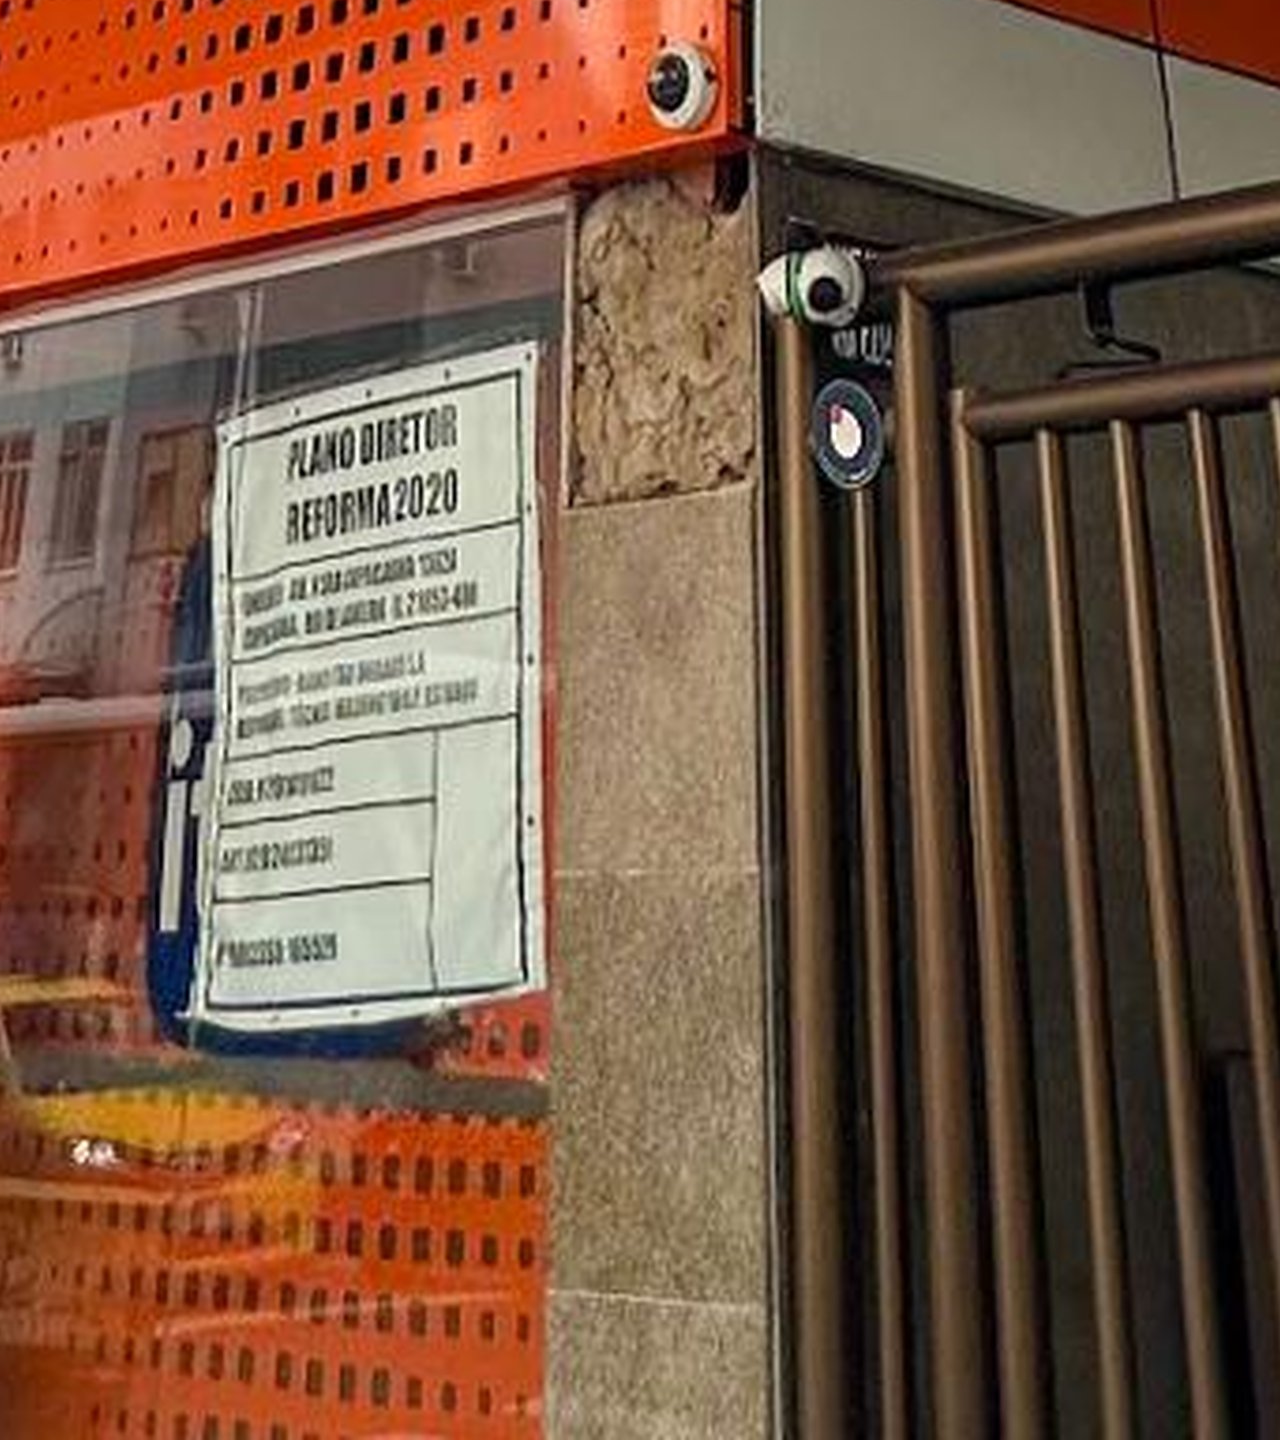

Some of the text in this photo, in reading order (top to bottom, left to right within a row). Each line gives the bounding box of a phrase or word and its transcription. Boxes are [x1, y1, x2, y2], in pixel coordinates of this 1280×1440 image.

[286, 403, 458, 481] PLANO DIRETOR
[286, 468, 458, 545] REFORMA 2020
